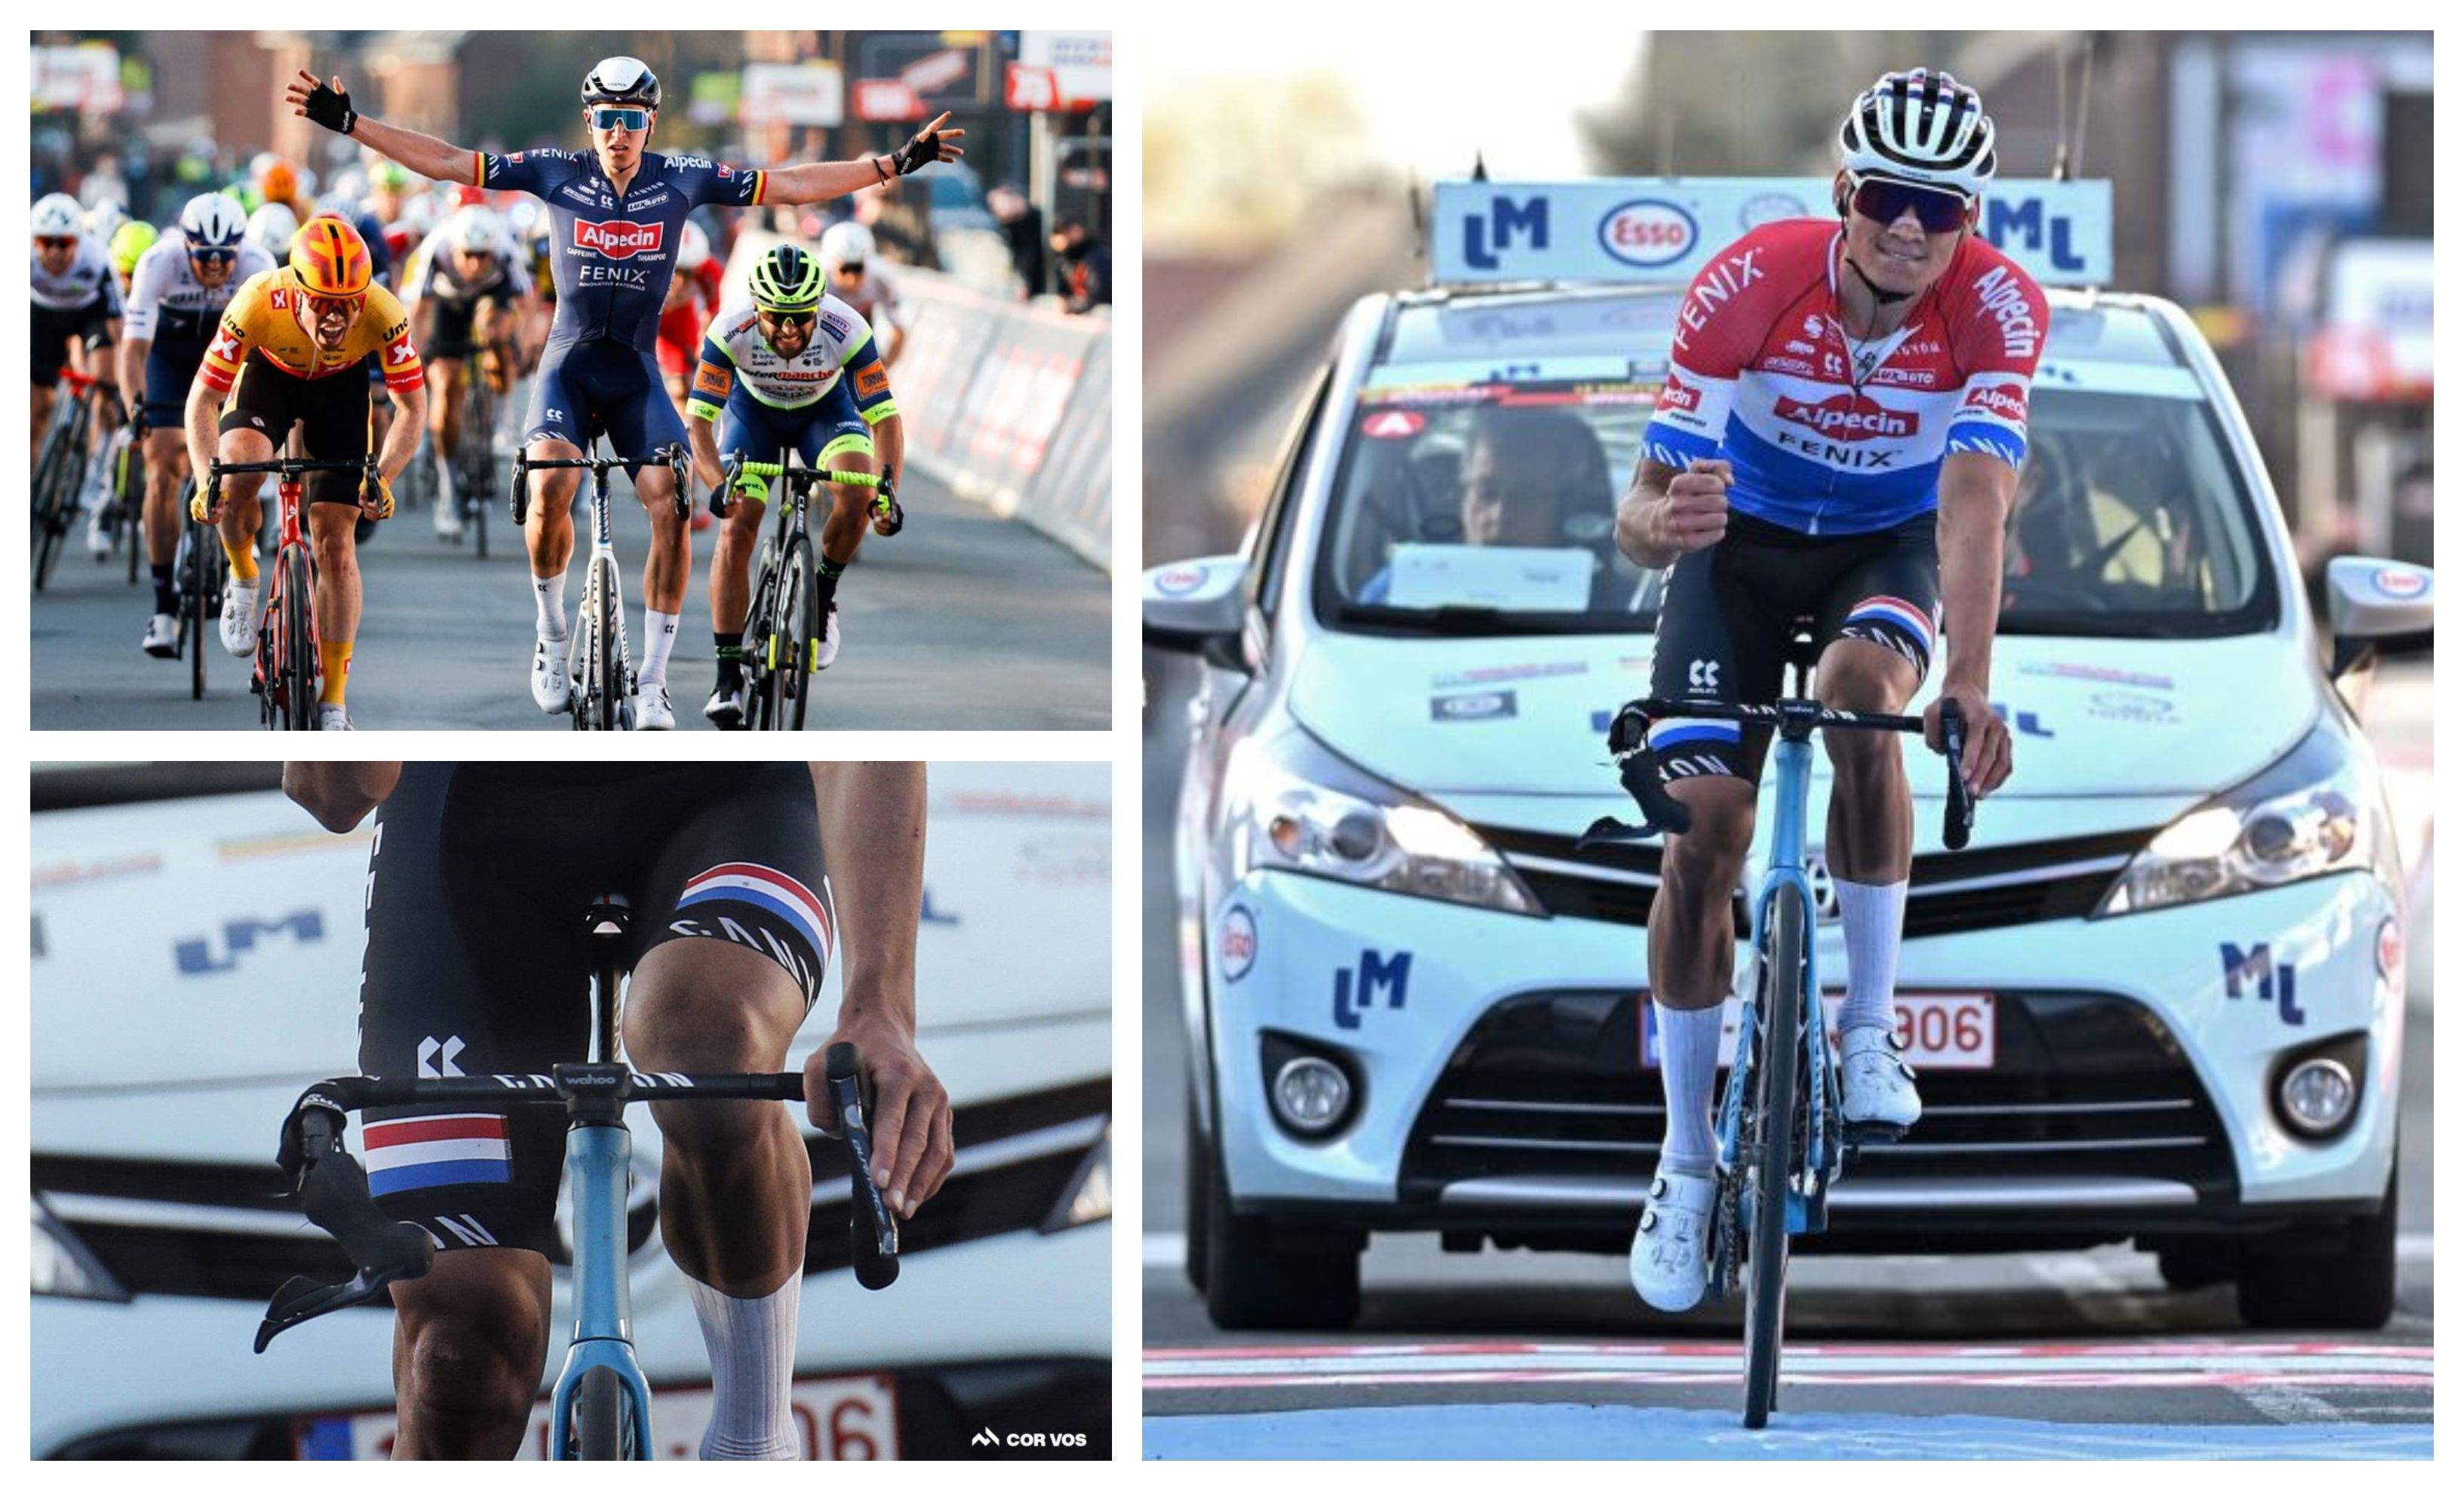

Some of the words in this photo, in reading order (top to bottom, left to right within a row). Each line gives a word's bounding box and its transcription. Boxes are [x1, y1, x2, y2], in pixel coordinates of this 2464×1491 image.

[532, 148, 578, 162] FENIX
[664, 156, 712, 174] Alpecin
[581, 226, 654, 251] Alpecin
[1465, 196, 1549, 270] LM
[1613, 217, 1686, 246] Esso
[637, 253, 667, 262] SHAMPOO
[580, 265, 645, 283] FENIX
[1674, 250, 1764, 351] FENIX
[1972, 266, 2041, 359] Alpecin
[1371, 411, 1415, 438] A
[1787, 407, 1906, 436] Alpecin
[1778, 431, 1892, 467] FENIX
[1334, 950, 1413, 1030] LM
[2219, 942, 2305, 1026] ML
[566, 1074, 616, 1085] wahoo
